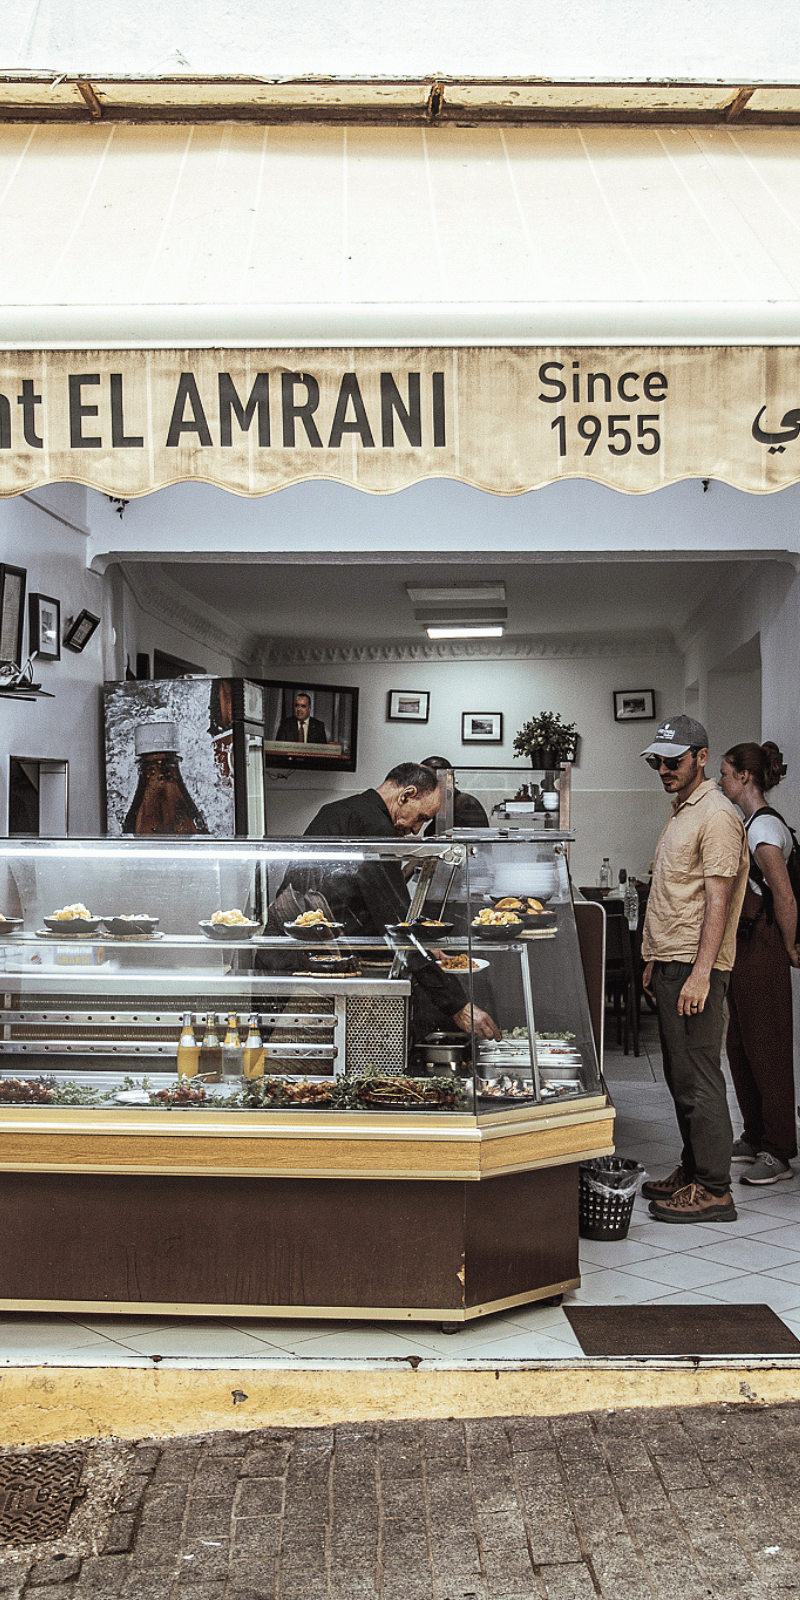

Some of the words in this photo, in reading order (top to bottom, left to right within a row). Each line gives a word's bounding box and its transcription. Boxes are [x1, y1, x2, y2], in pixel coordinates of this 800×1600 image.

[538, 361, 668, 403] Since
[68, 373, 144, 449] EL
[165, 372, 446, 448] AMRANI
[551, 414, 661, 457] 1955
